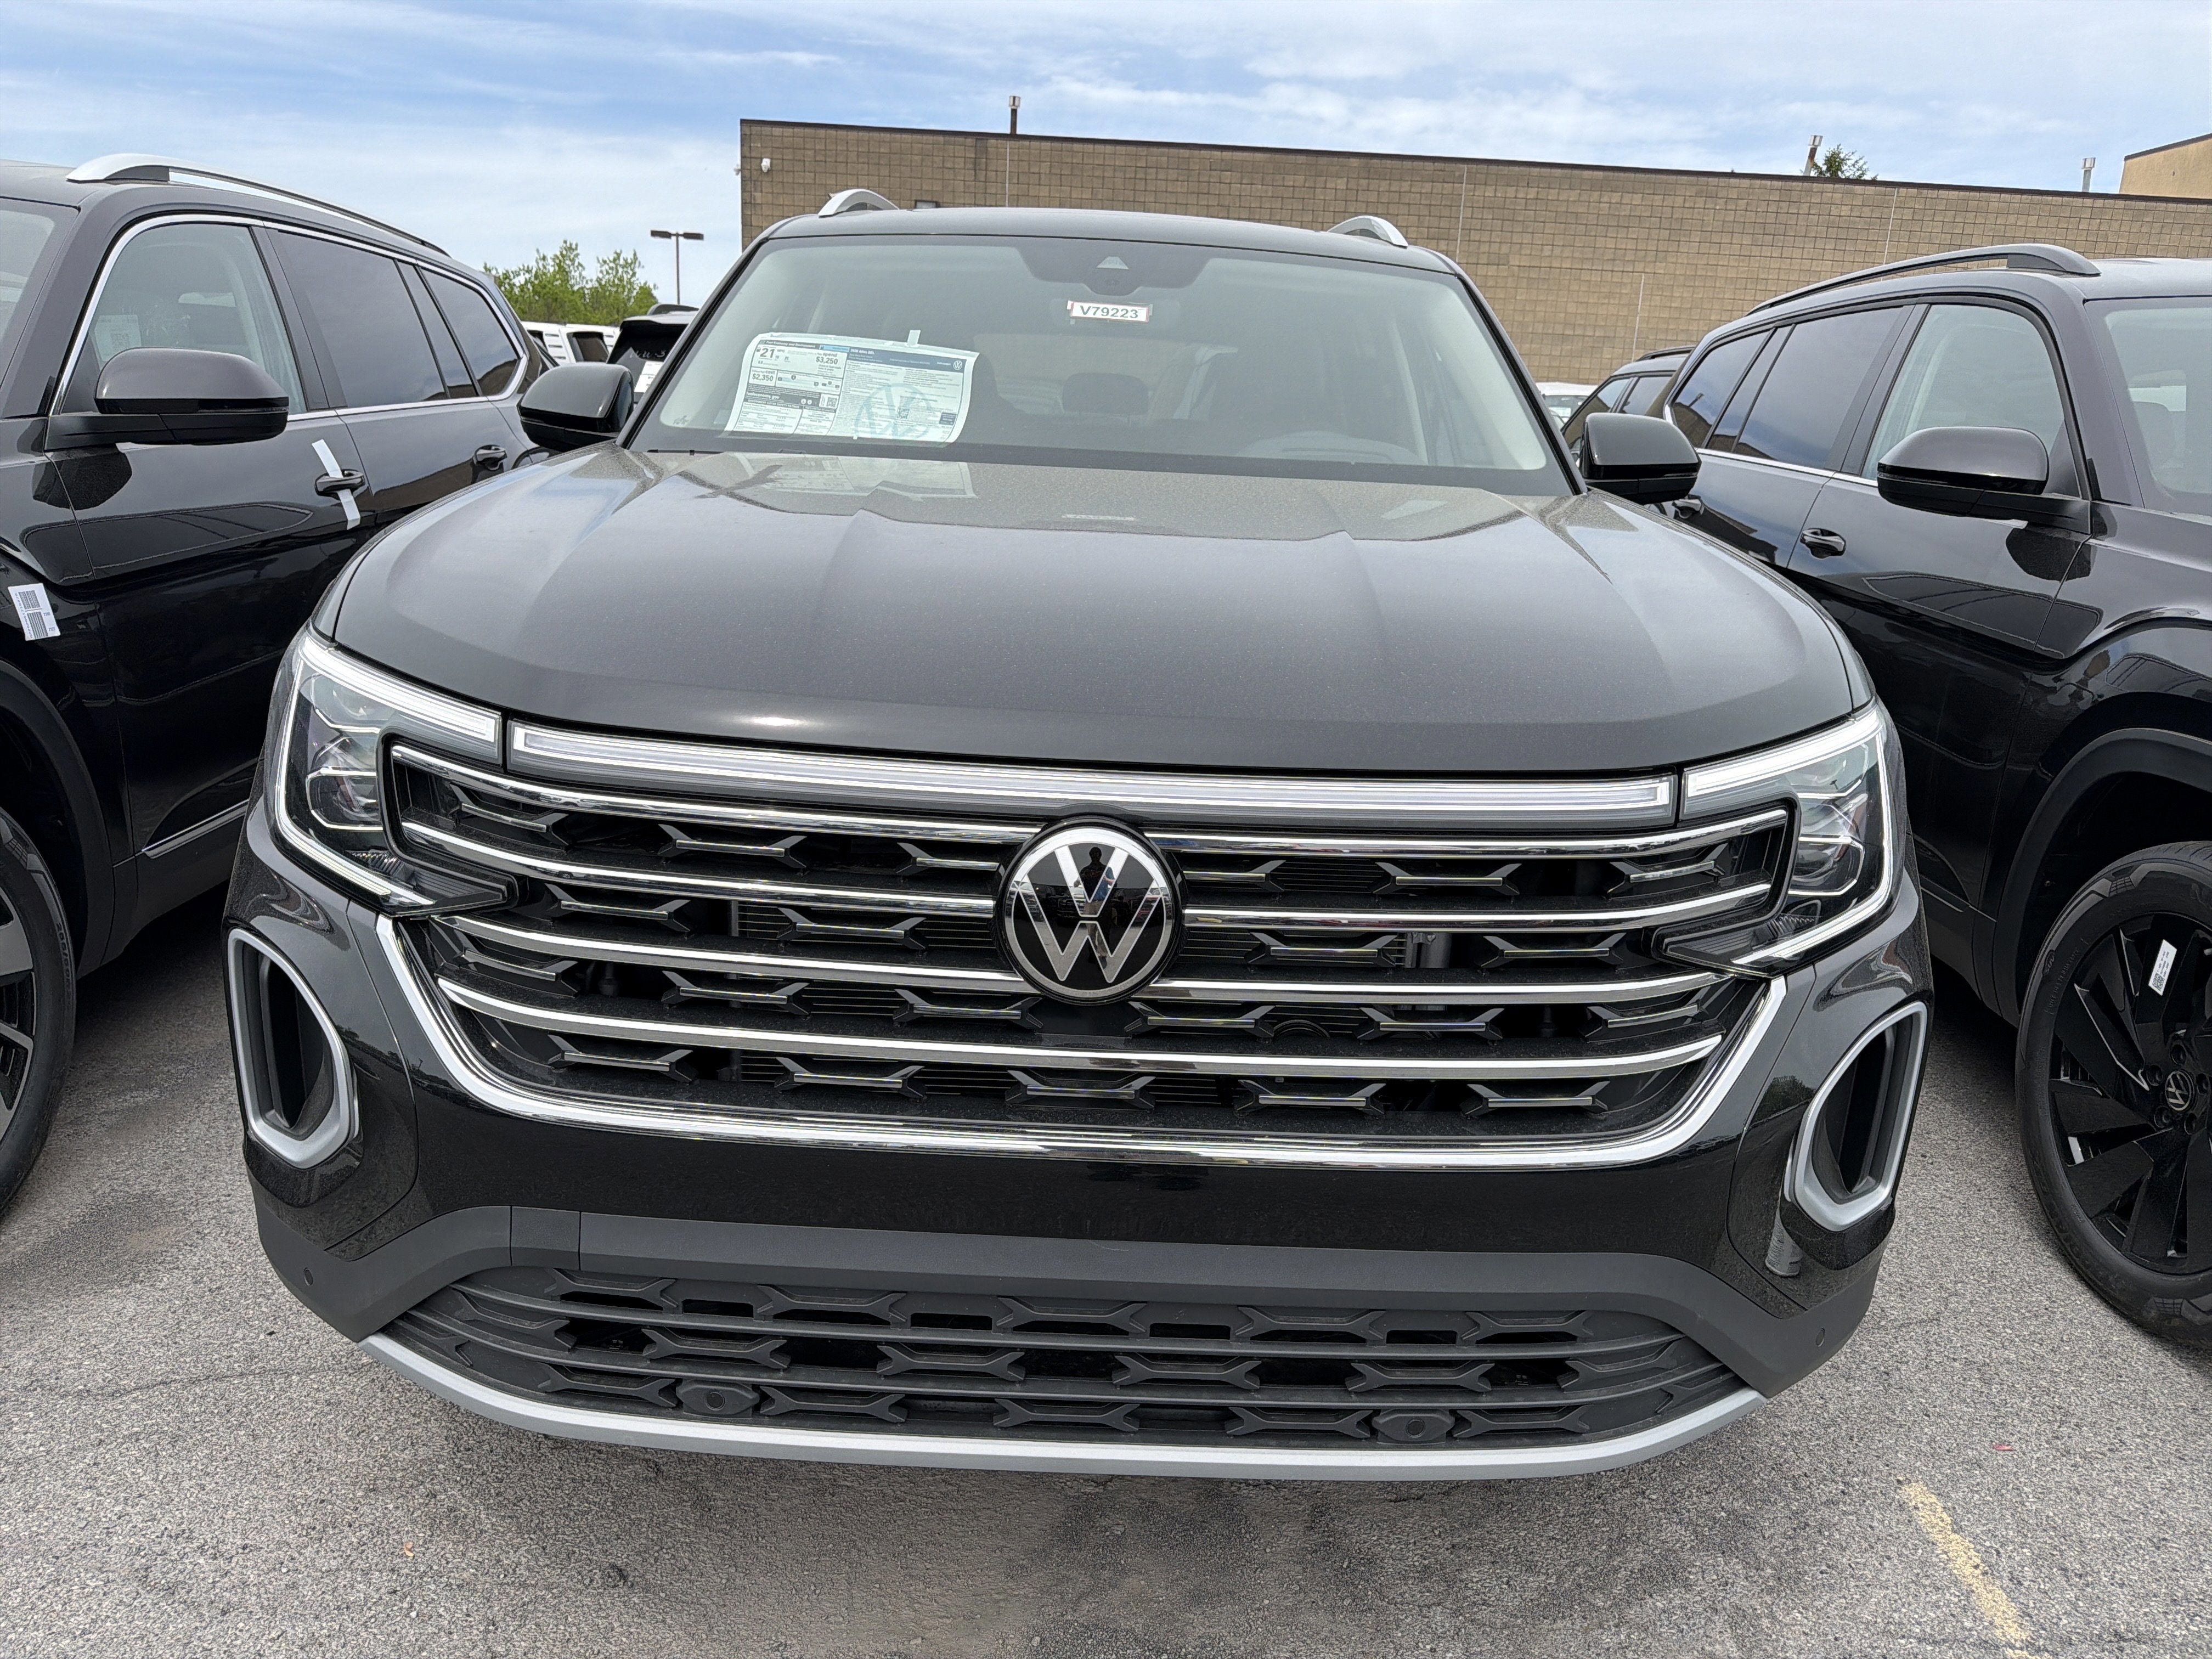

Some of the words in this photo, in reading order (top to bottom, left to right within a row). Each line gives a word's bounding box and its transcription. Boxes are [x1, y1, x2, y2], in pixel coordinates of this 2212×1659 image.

[1080, 306, 1138, 319] V79223
[760, 348, 775, 358] 21
[752, 373, 774, 382] $2,350
